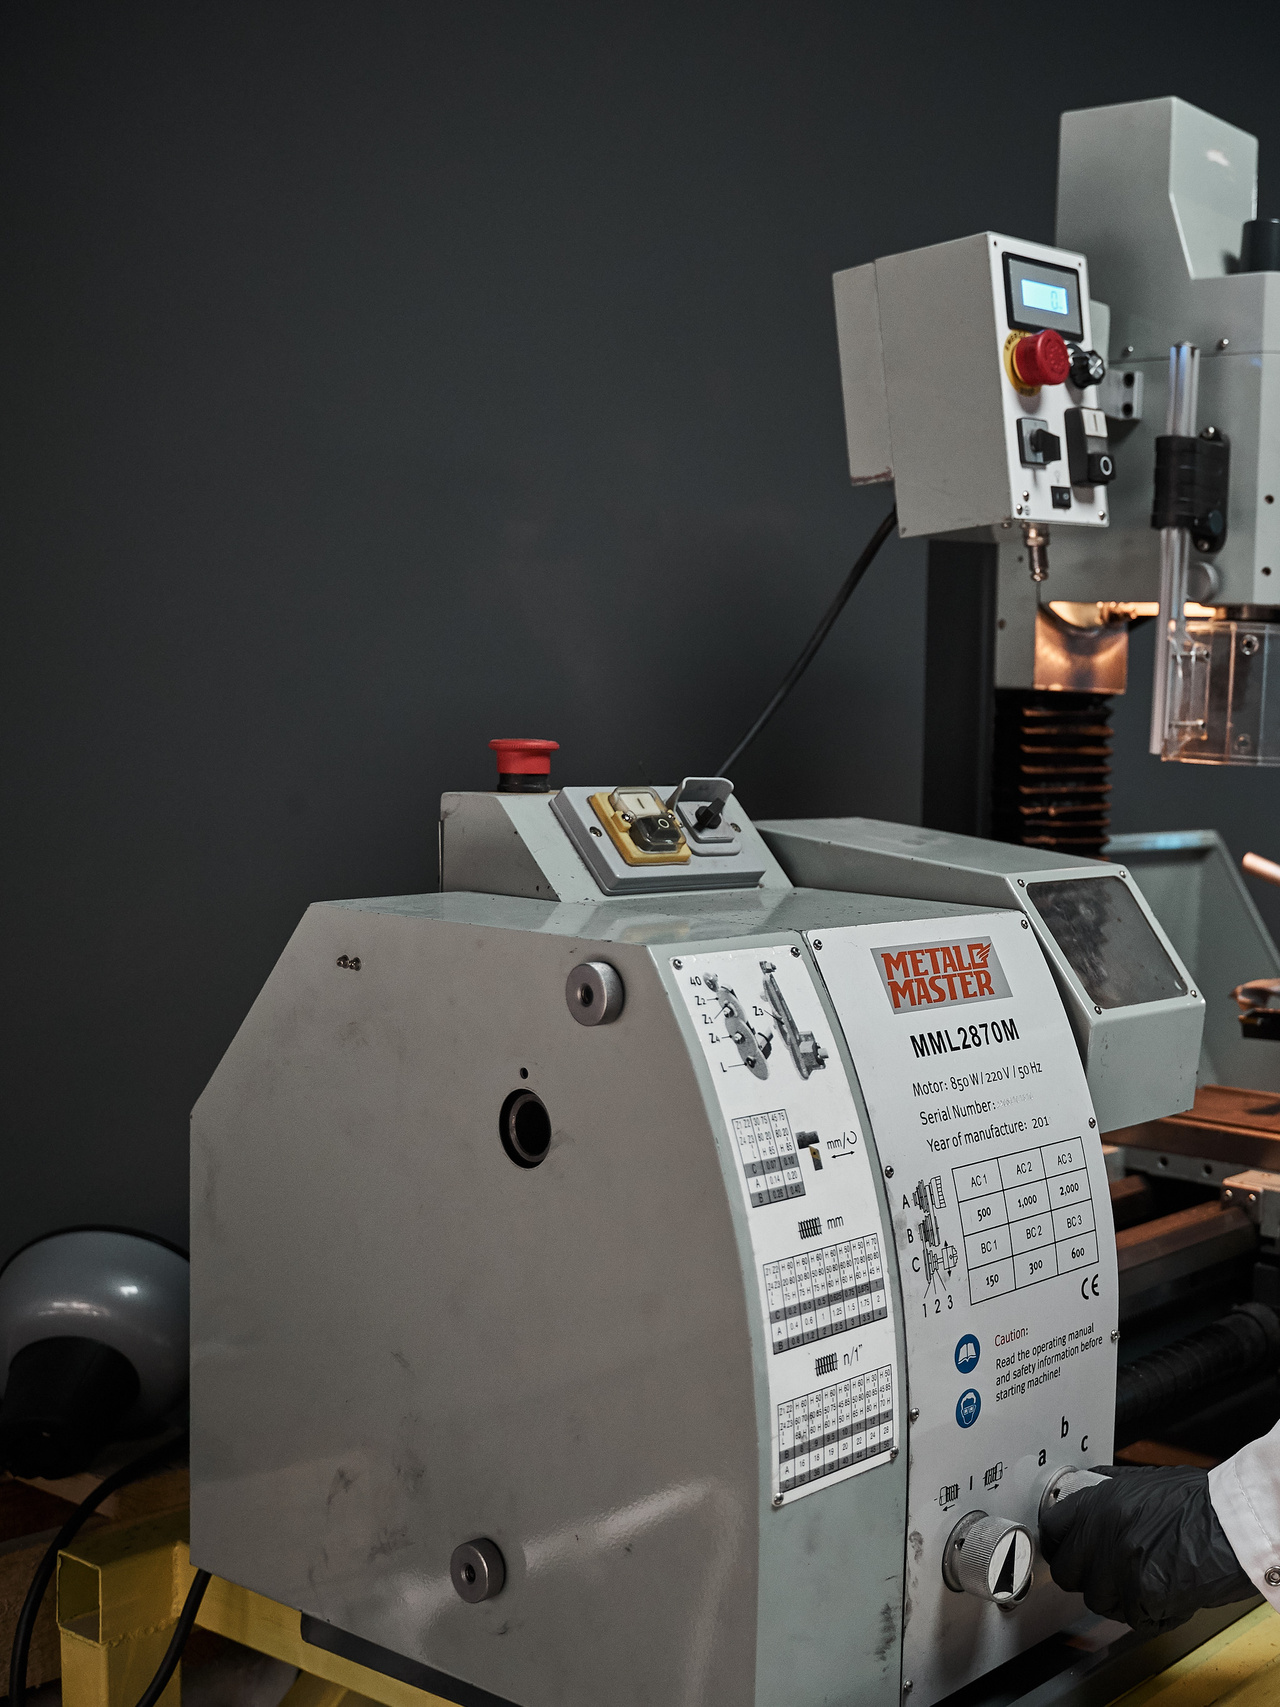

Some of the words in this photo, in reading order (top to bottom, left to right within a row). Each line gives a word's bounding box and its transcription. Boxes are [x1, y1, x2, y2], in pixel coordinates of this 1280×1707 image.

[881, 946, 971, 980] METAL
[690, 976, 702, 987] 40
[888, 970, 995, 1008] MASTER
[910, 1018, 1020, 1058] MML2870M
[720, 1062, 727, 1073] L
[913, 1079, 948, 1097] Motor:
[919, 1108, 952, 1126] Serial
[952, 1101, 996, 1119] Number:
[927, 1136, 950, 1153] Year
[952, 1132, 962, 1148] of
[964, 1121, 1028, 1143] manufacture:
[902, 1195, 910, 1209] A
[977, 1208, 992, 1222] 500
[1018, 1195, 1038, 1209] 1,000
[1059, 1182, 1080, 1196] 2,000
[827, 1216, 844, 1230] mm
[907, 1228, 914, 1244] B
[912, 1257, 921, 1273] C
[986, 1274, 1000, 1286] 150
[1029, 1260, 1043, 1275] 300
[1071, 1247, 1085, 1259] 600
[923, 1303, 927, 1318] 1
[934, 1299, 941, 1314] 2
[947, 1295, 954, 1310] 3
[994, 1327, 1029, 1347] Caution:
[996, 1355, 1015, 1370] Read
[1017, 1351, 1031, 1364] the
[1032, 1336, 1067, 1358] operating
[1068, 1322, 1095, 1342] manual
[996, 1371, 1011, 1386] and
[1013, 1364, 1036, 1380] safety
[1038, 1348, 1079, 1369] information
[1080, 1336, 1103, 1352] before
[996, 1382, 1026, 1402] starting
[1027, 1368, 1061, 1389] machine!
[1061, 1416, 1069, 1439] b
[1081, 1434, 1089, 1453] c
[1038, 1449, 1047, 1467] a
